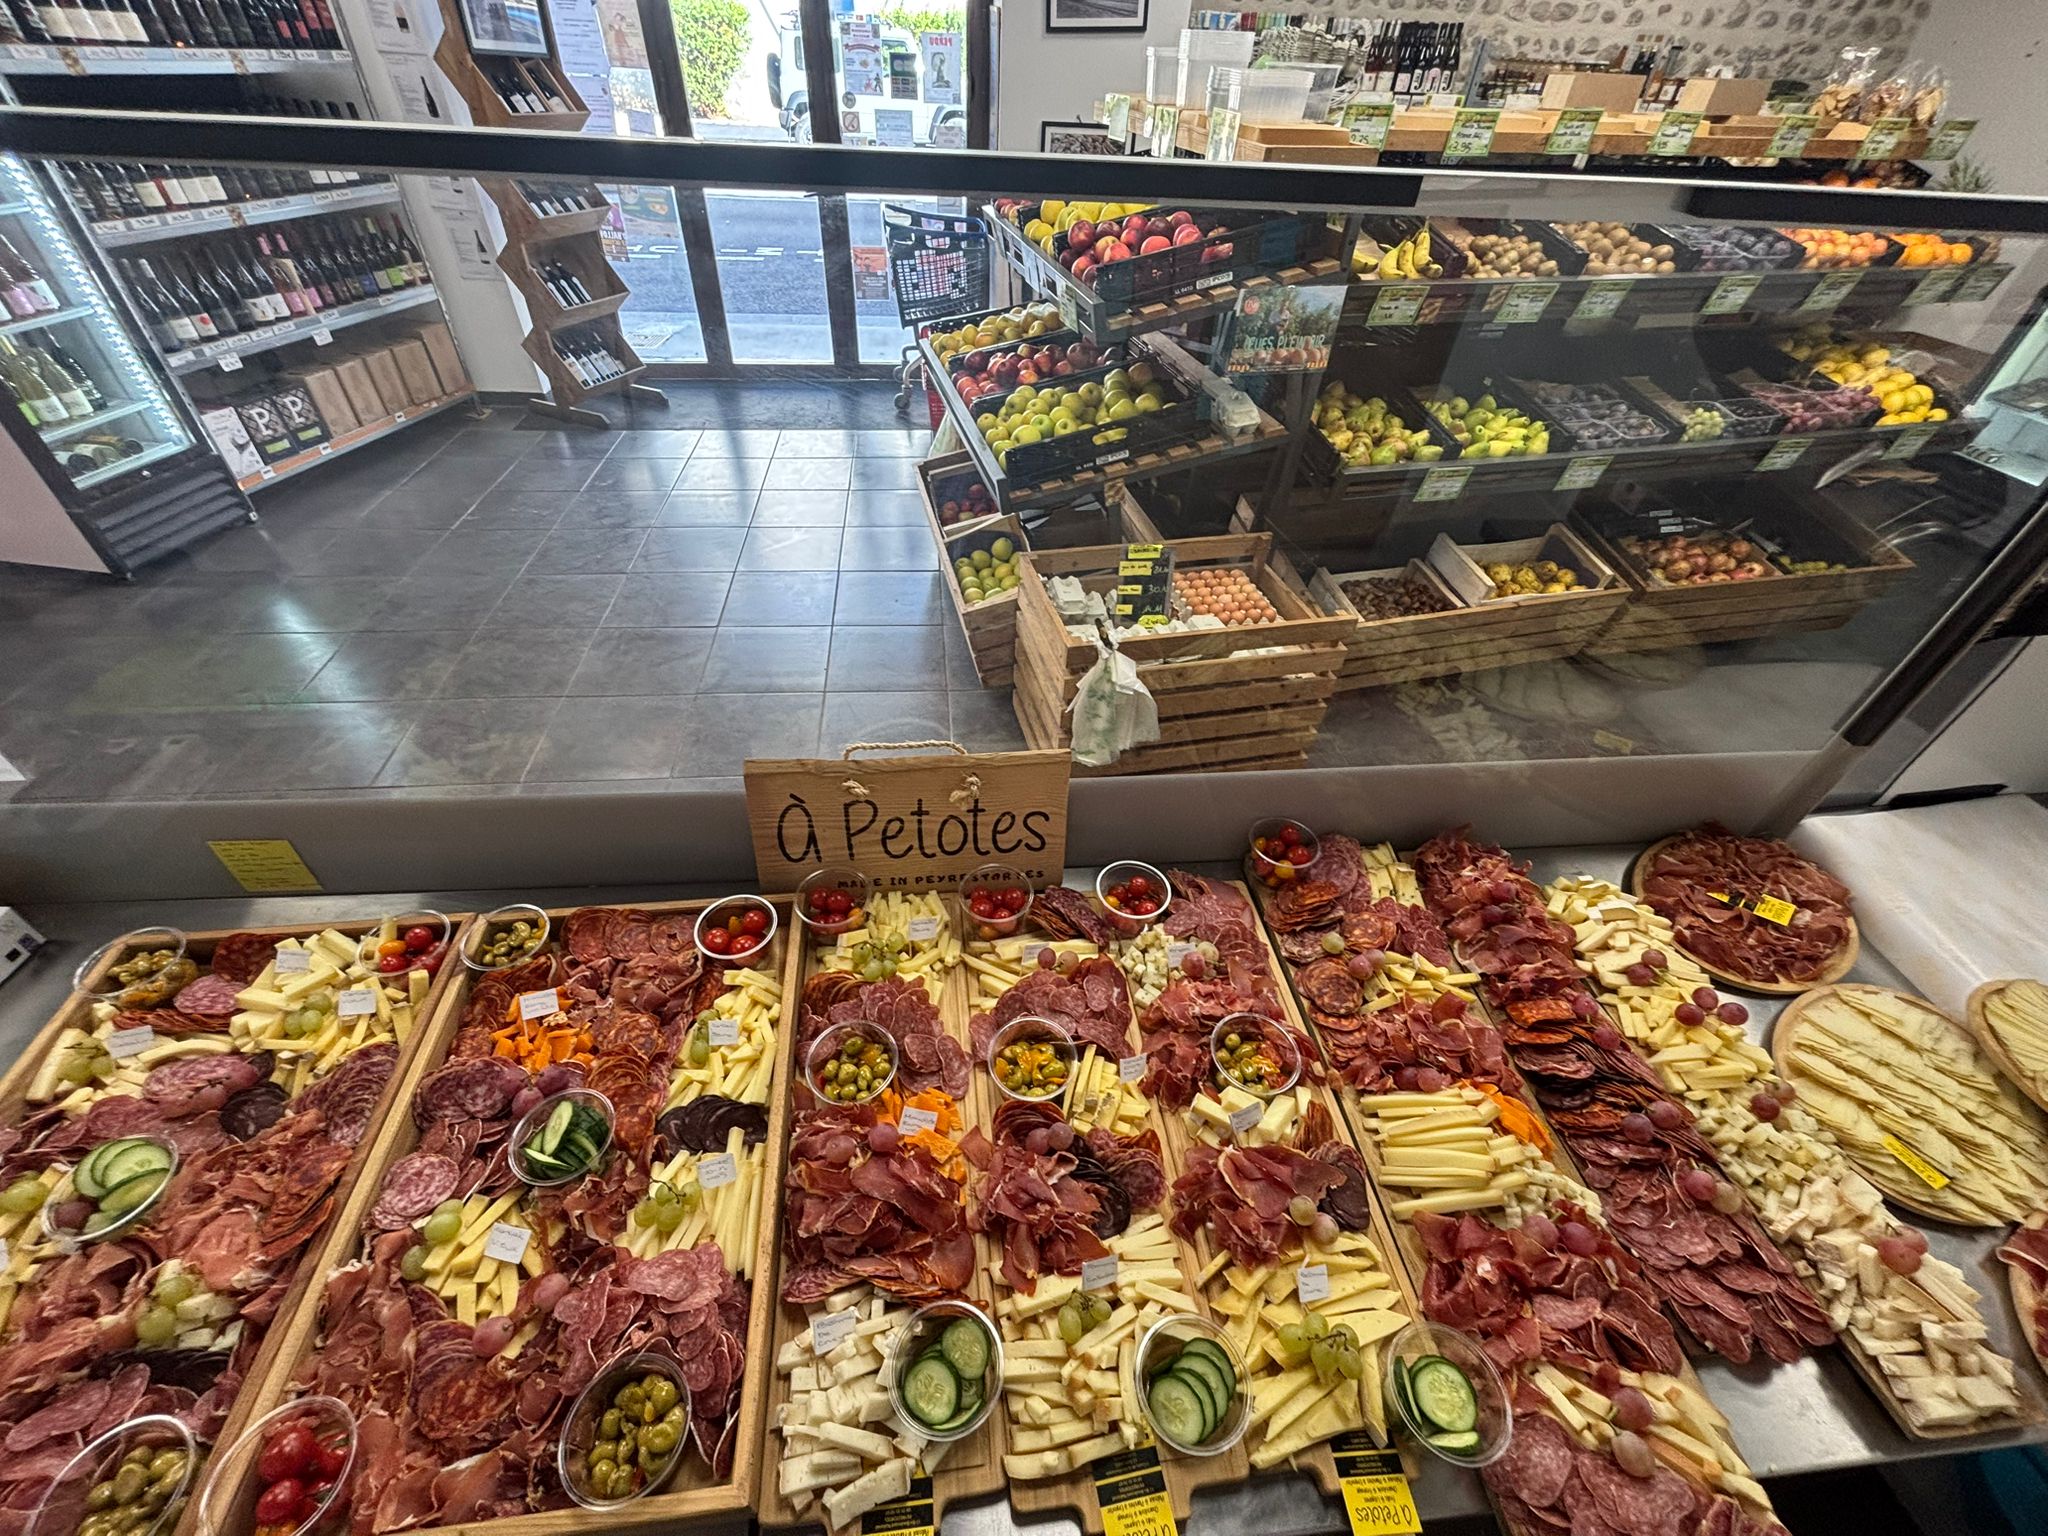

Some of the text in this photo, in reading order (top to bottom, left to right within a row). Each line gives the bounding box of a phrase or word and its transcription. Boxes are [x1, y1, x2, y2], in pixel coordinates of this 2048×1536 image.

[777, 793, 1050, 863] À Petotes
[890, 877, 908, 885] IN
[1355, 1504, 1401, 1526] Petotes
